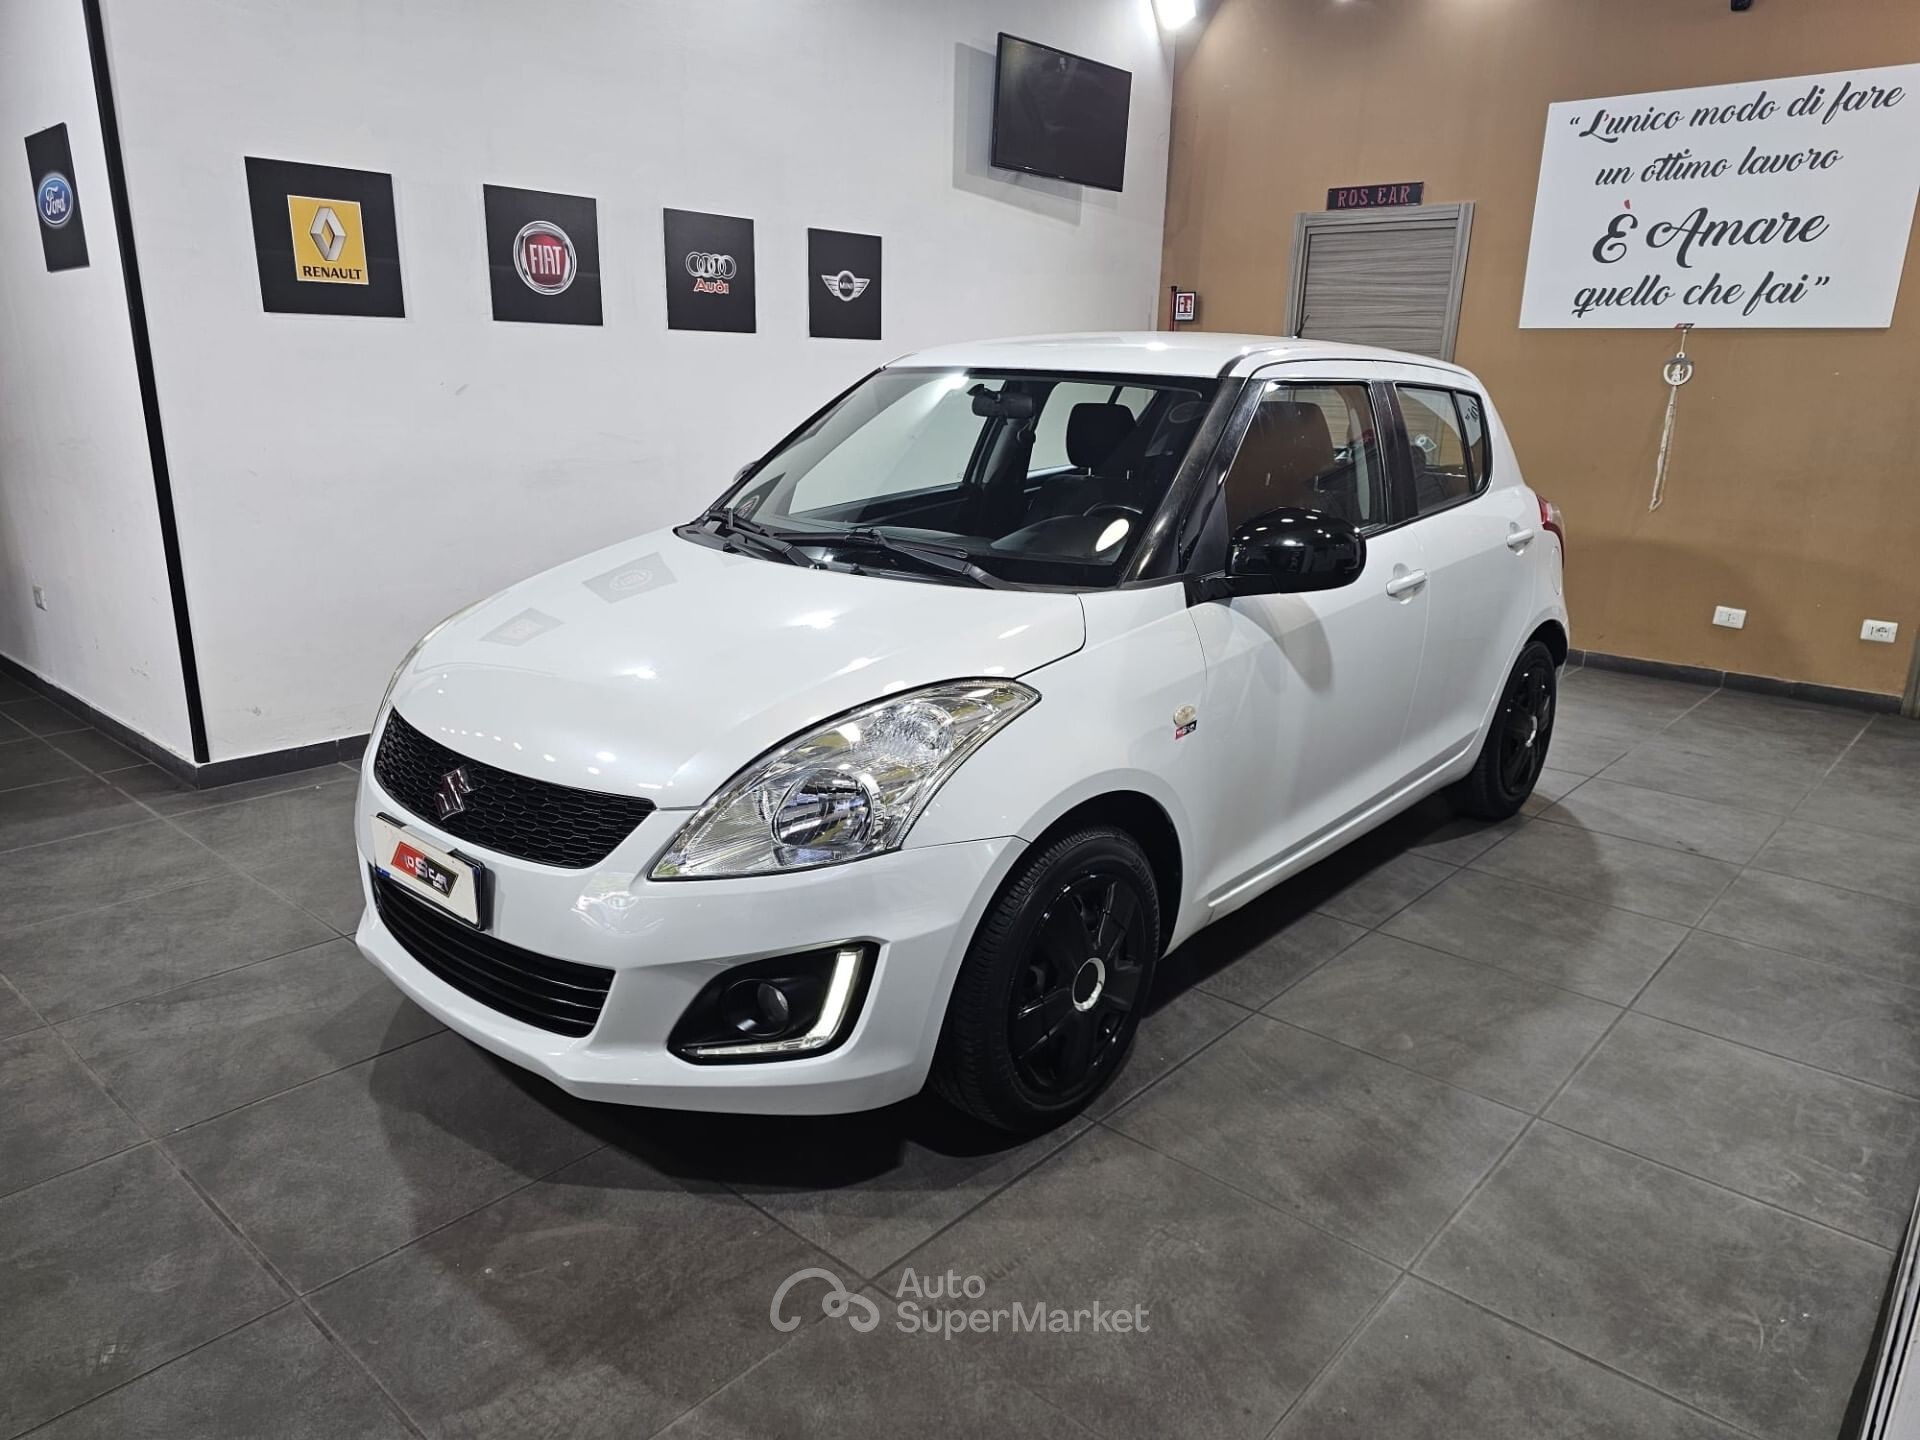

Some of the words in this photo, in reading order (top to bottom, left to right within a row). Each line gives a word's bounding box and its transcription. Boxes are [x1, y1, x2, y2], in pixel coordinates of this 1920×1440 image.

[1689, 91, 1780, 128] modo
[1787, 85, 1826, 118] di
[1821, 81, 1907, 126] fare
[1595, 162, 1635, 186] un
[1641, 148, 1732, 183] ottimo
[1737, 146, 1845, 177] lavoro
[45, 186, 67, 216] Ford
[1645, 207, 1830, 269] Amare
[302, 264, 363, 280] RENAULT
[529, 243, 563, 276] FIAT
[693, 278, 730, 295] Audi
[1571, 274, 1676, 319] quello
[1682, 272, 1745, 307] che
